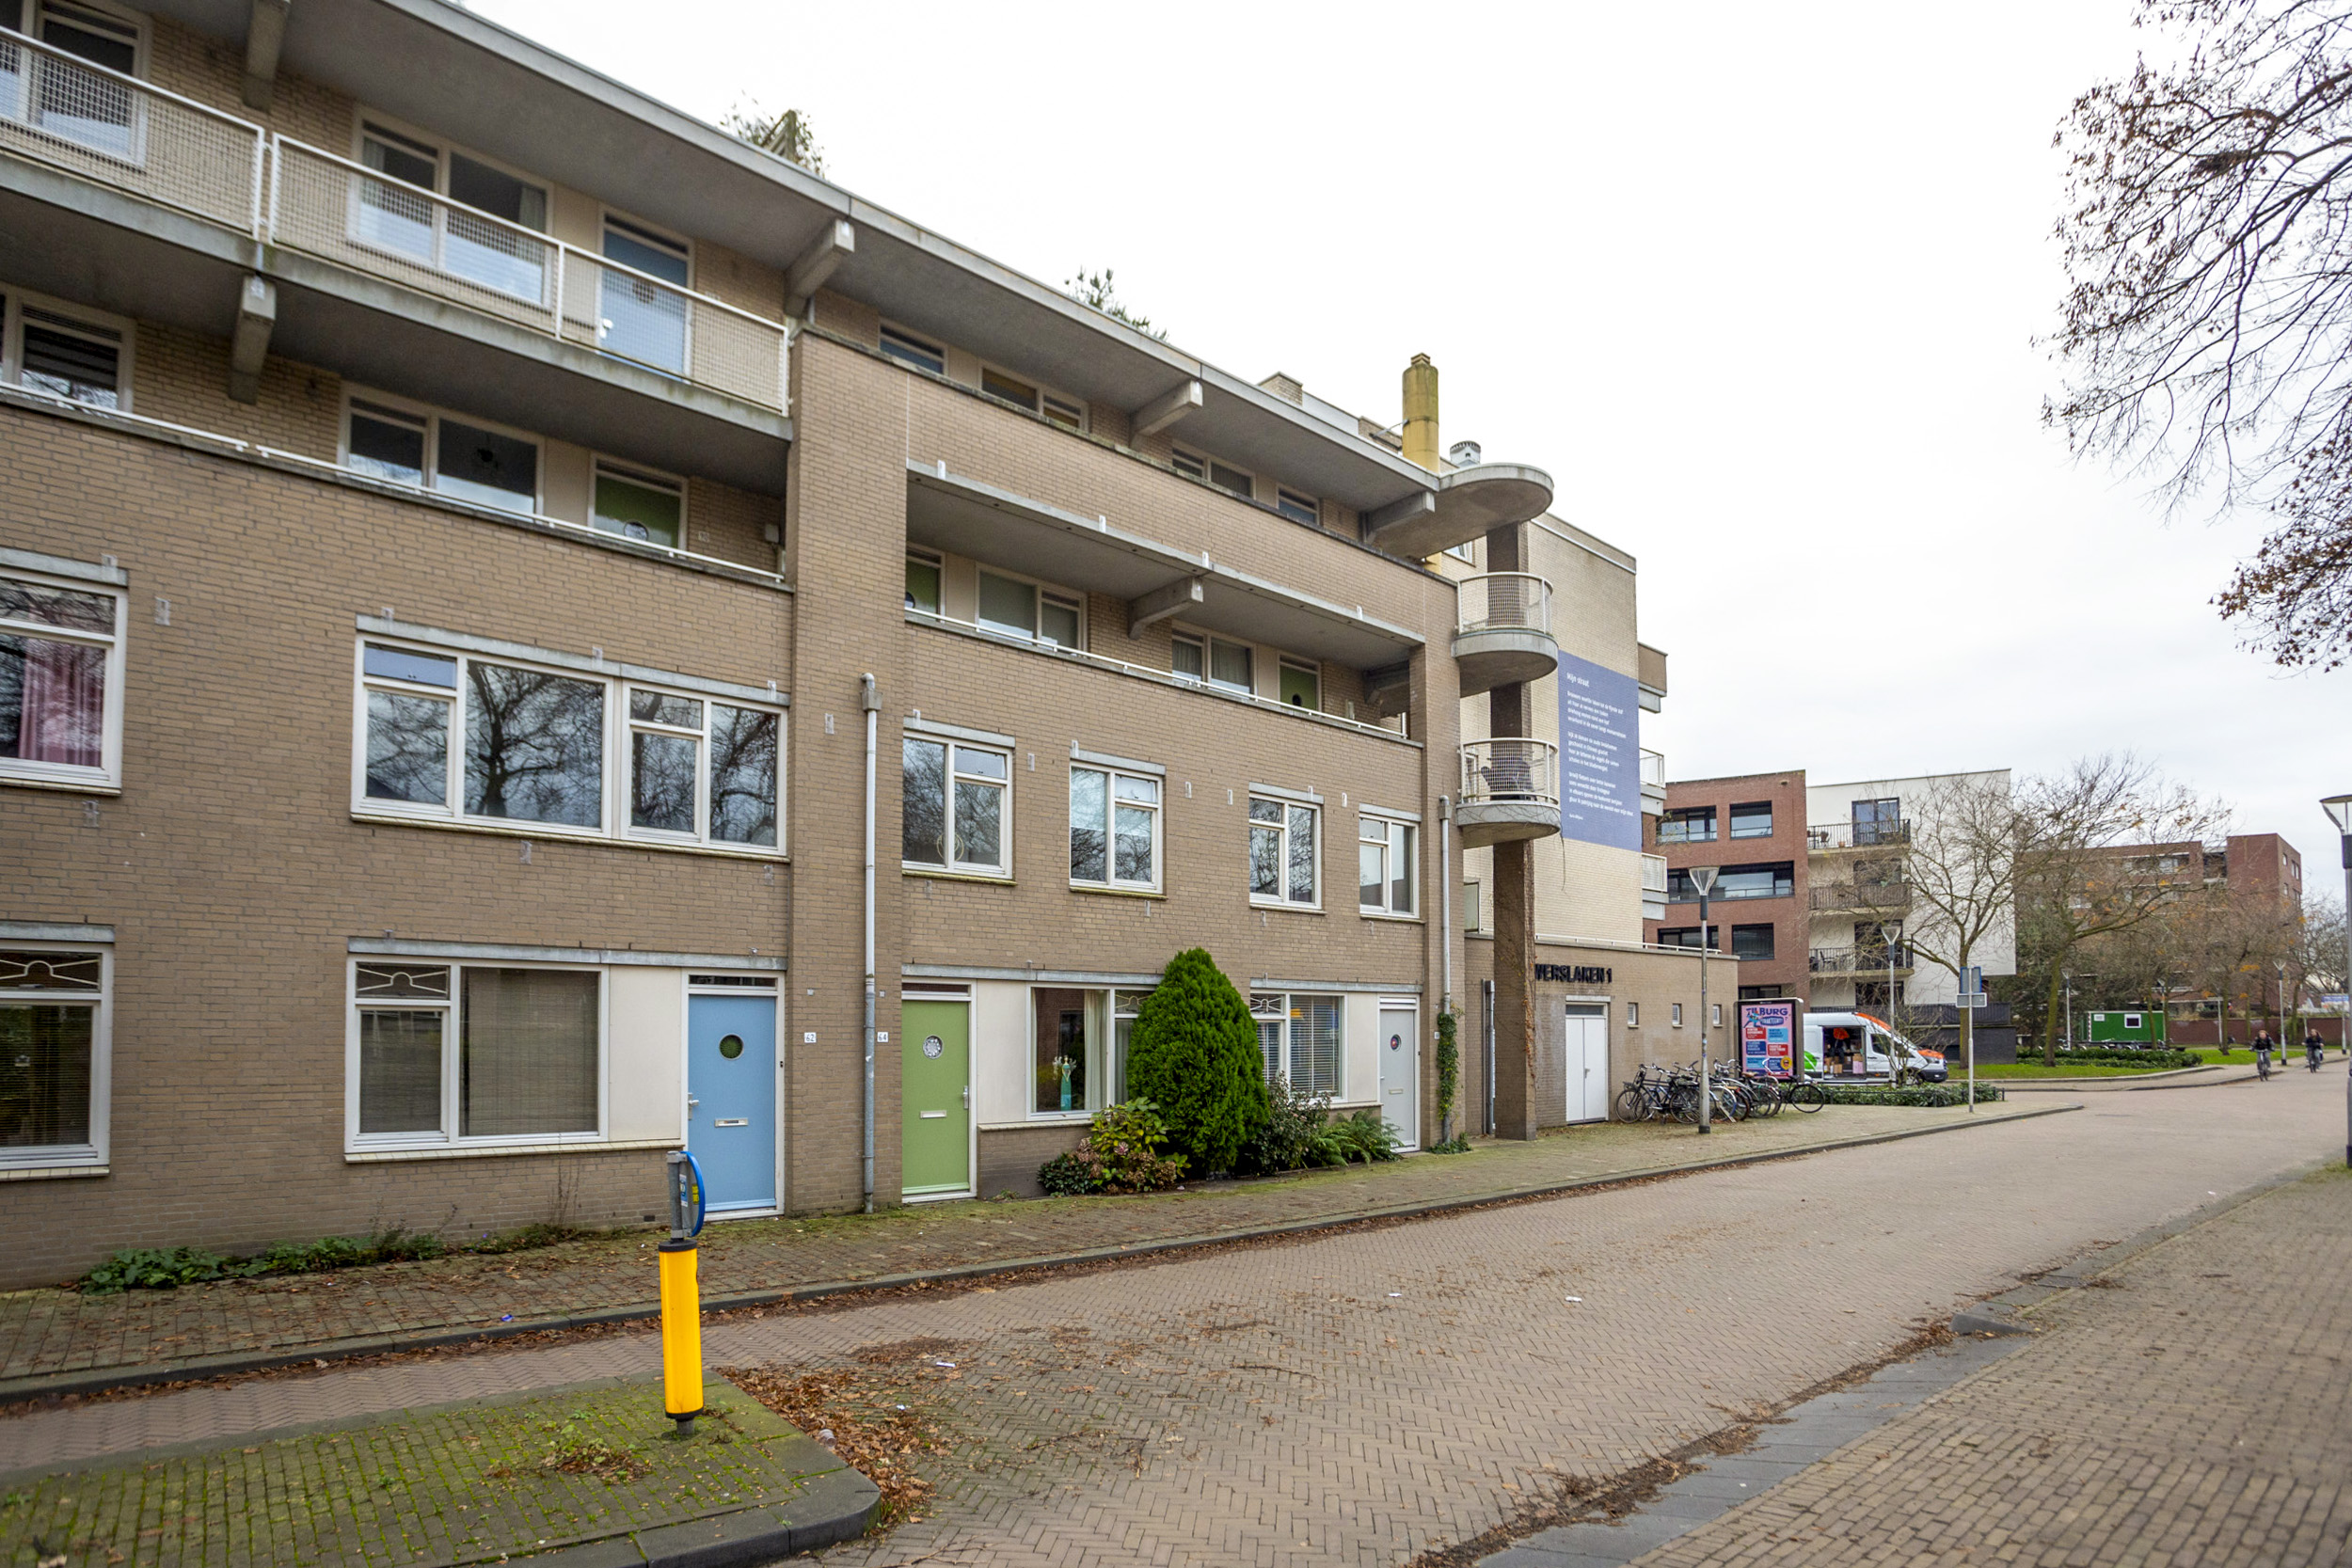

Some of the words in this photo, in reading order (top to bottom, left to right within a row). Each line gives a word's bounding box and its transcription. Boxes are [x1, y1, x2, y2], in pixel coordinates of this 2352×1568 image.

[1606, 967, 1613, 984] 1
[805, 1034, 815, 1042] 62
[878, 1033, 887, 1041] 64
